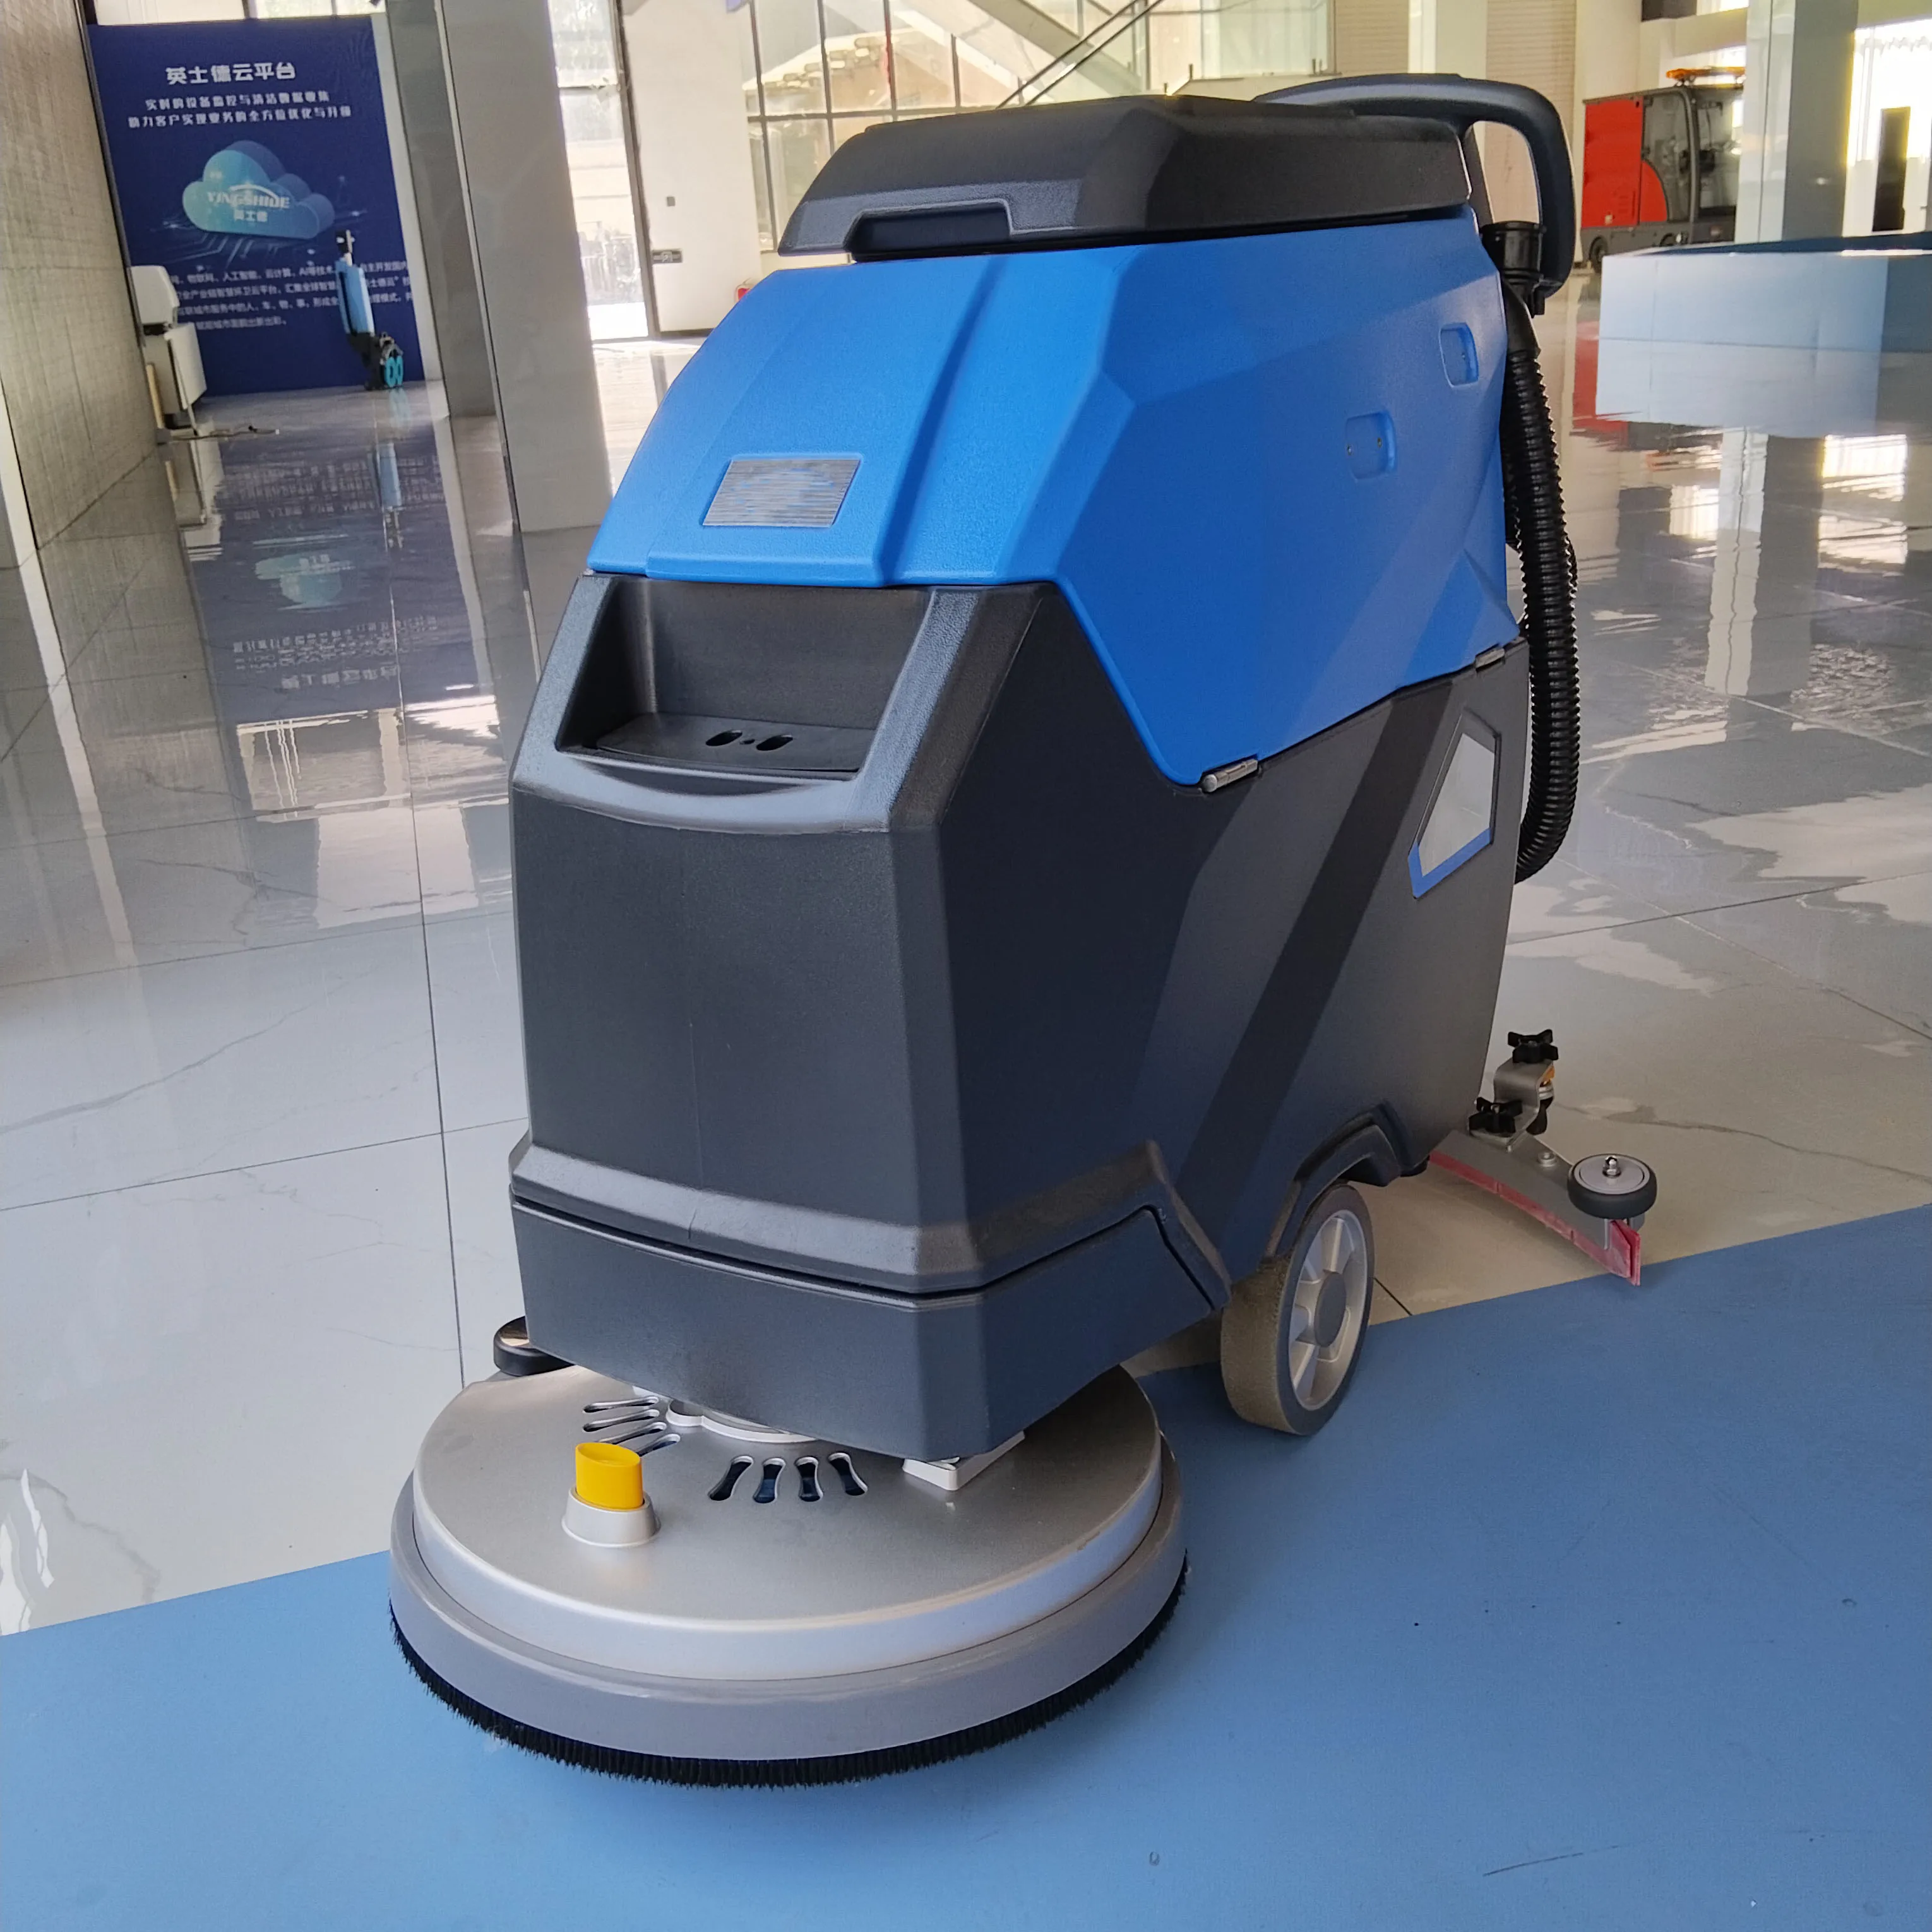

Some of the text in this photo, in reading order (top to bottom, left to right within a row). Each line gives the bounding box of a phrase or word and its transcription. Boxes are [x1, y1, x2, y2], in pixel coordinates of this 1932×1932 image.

[166, 62, 295, 85] 英士德云平台
